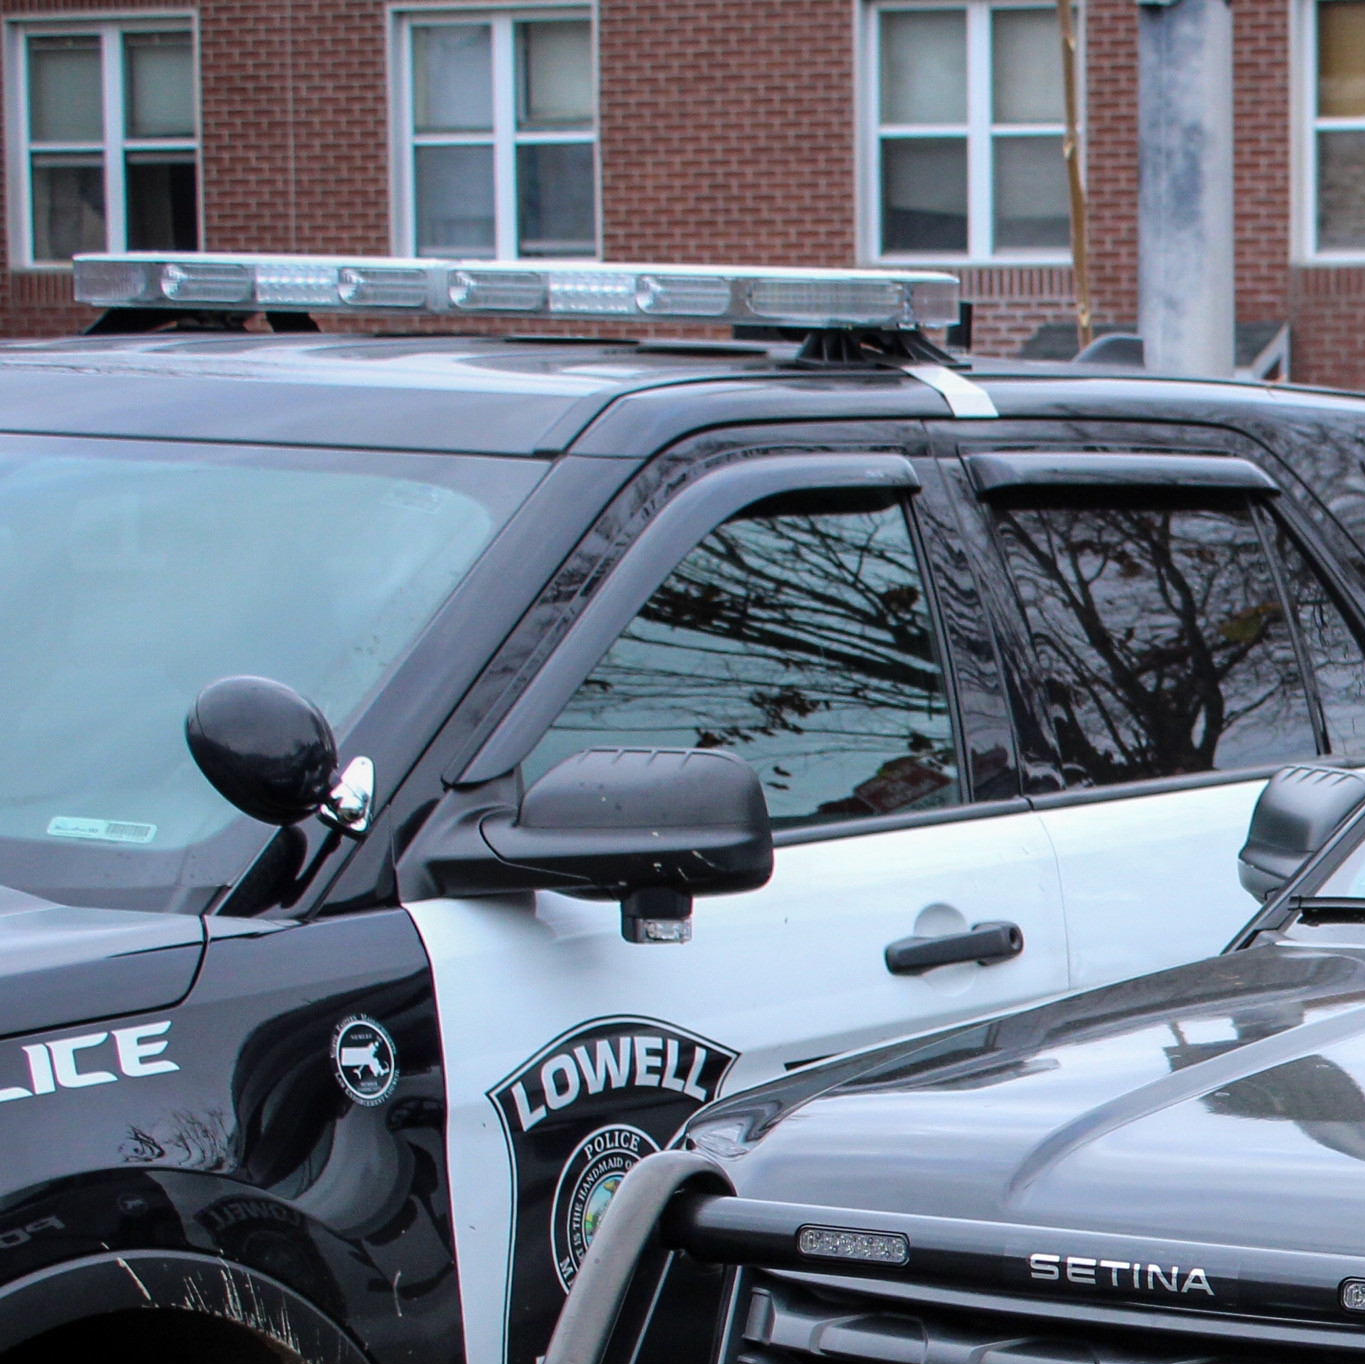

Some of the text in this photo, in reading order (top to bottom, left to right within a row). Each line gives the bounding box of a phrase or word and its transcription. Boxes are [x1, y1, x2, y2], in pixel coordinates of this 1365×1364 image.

[511, 1036, 707, 1132] LOWELL
[583, 1130, 641, 1160] POLICE
[578, 1157, 623, 1200] HANDMAID
[1030, 1253, 1215, 1296] SETINA
